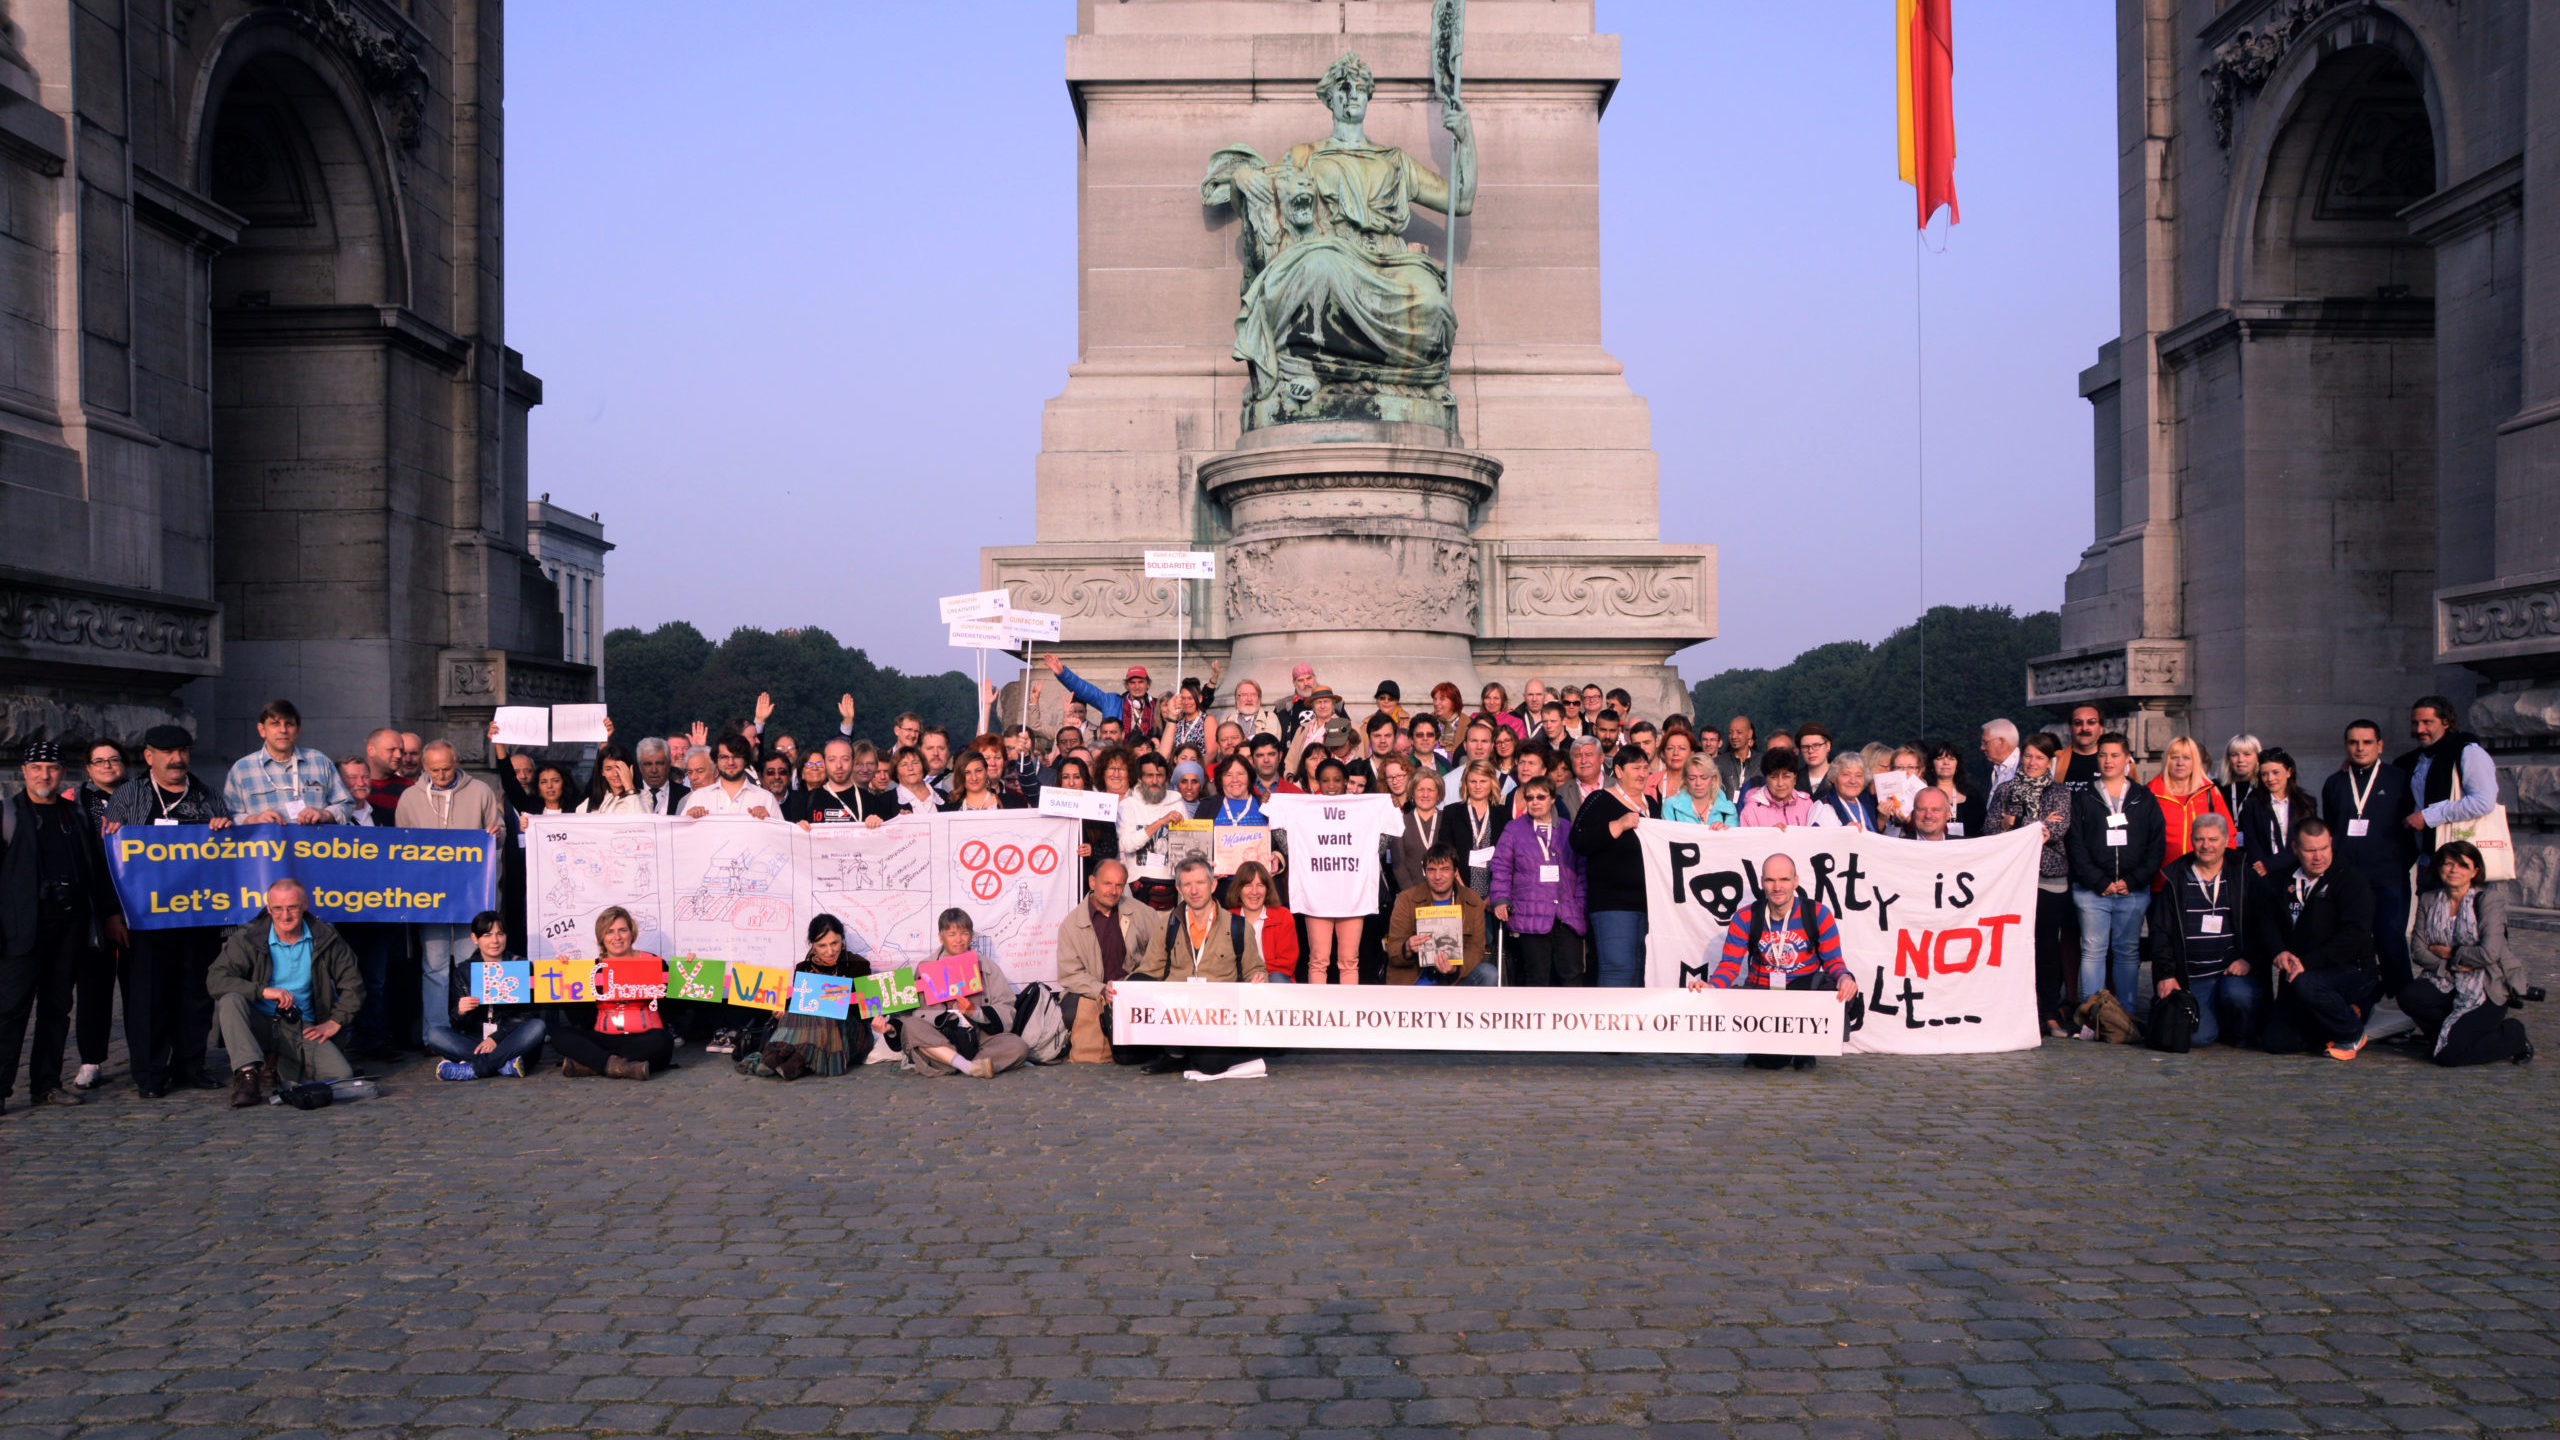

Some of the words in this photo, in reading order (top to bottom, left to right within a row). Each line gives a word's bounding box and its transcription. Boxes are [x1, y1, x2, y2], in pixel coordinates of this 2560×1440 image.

[1146, 561, 1196, 569] SOLIDARITEIT
[1049, 799, 1079, 809] SAMEN
[1323, 806, 1346, 821] We
[120, 837, 287, 862] Pomóżmy
[293, 837, 379, 859] sobie
[388, 844, 482, 862] razem
[546, 832, 568, 842] 1950
[1317, 832, 1352, 846] want
[1310, 857, 1359, 872] RIGHTS!
[313, 886, 446, 913] together
[546, 918, 576, 938] 2014
[1894, 914, 2021, 980] NOT
[483, 961, 520, 1004] Be
[540, 966, 584, 1001] the
[589, 962, 667, 1011] Change
[676, 960, 714, 999] You
[732, 967, 785, 1008] Want
[867, 970, 919, 1008] The
[921, 962, 984, 998] World
[793, 978, 820, 1012] to
[858, 991, 882, 1019] in
[1130, 1007, 1155, 1025] BE
[1160, 1007, 1238, 1026] AWARE:
[1243, 1009, 1350, 1028] MATERIAL
[1355, 1010, 1452, 1029] POVERTY
[1455, 1011, 1474, 1030] IS
[1480, 1012, 1545, 1030] SPIRIT
[1551, 1012, 1648, 1031] POVERTY
[1653, 1014, 1679, 1032] OF
[1684, 1014, 1727, 1032] THE
[1731, 1015, 1830, 1035] SOCIETY!
